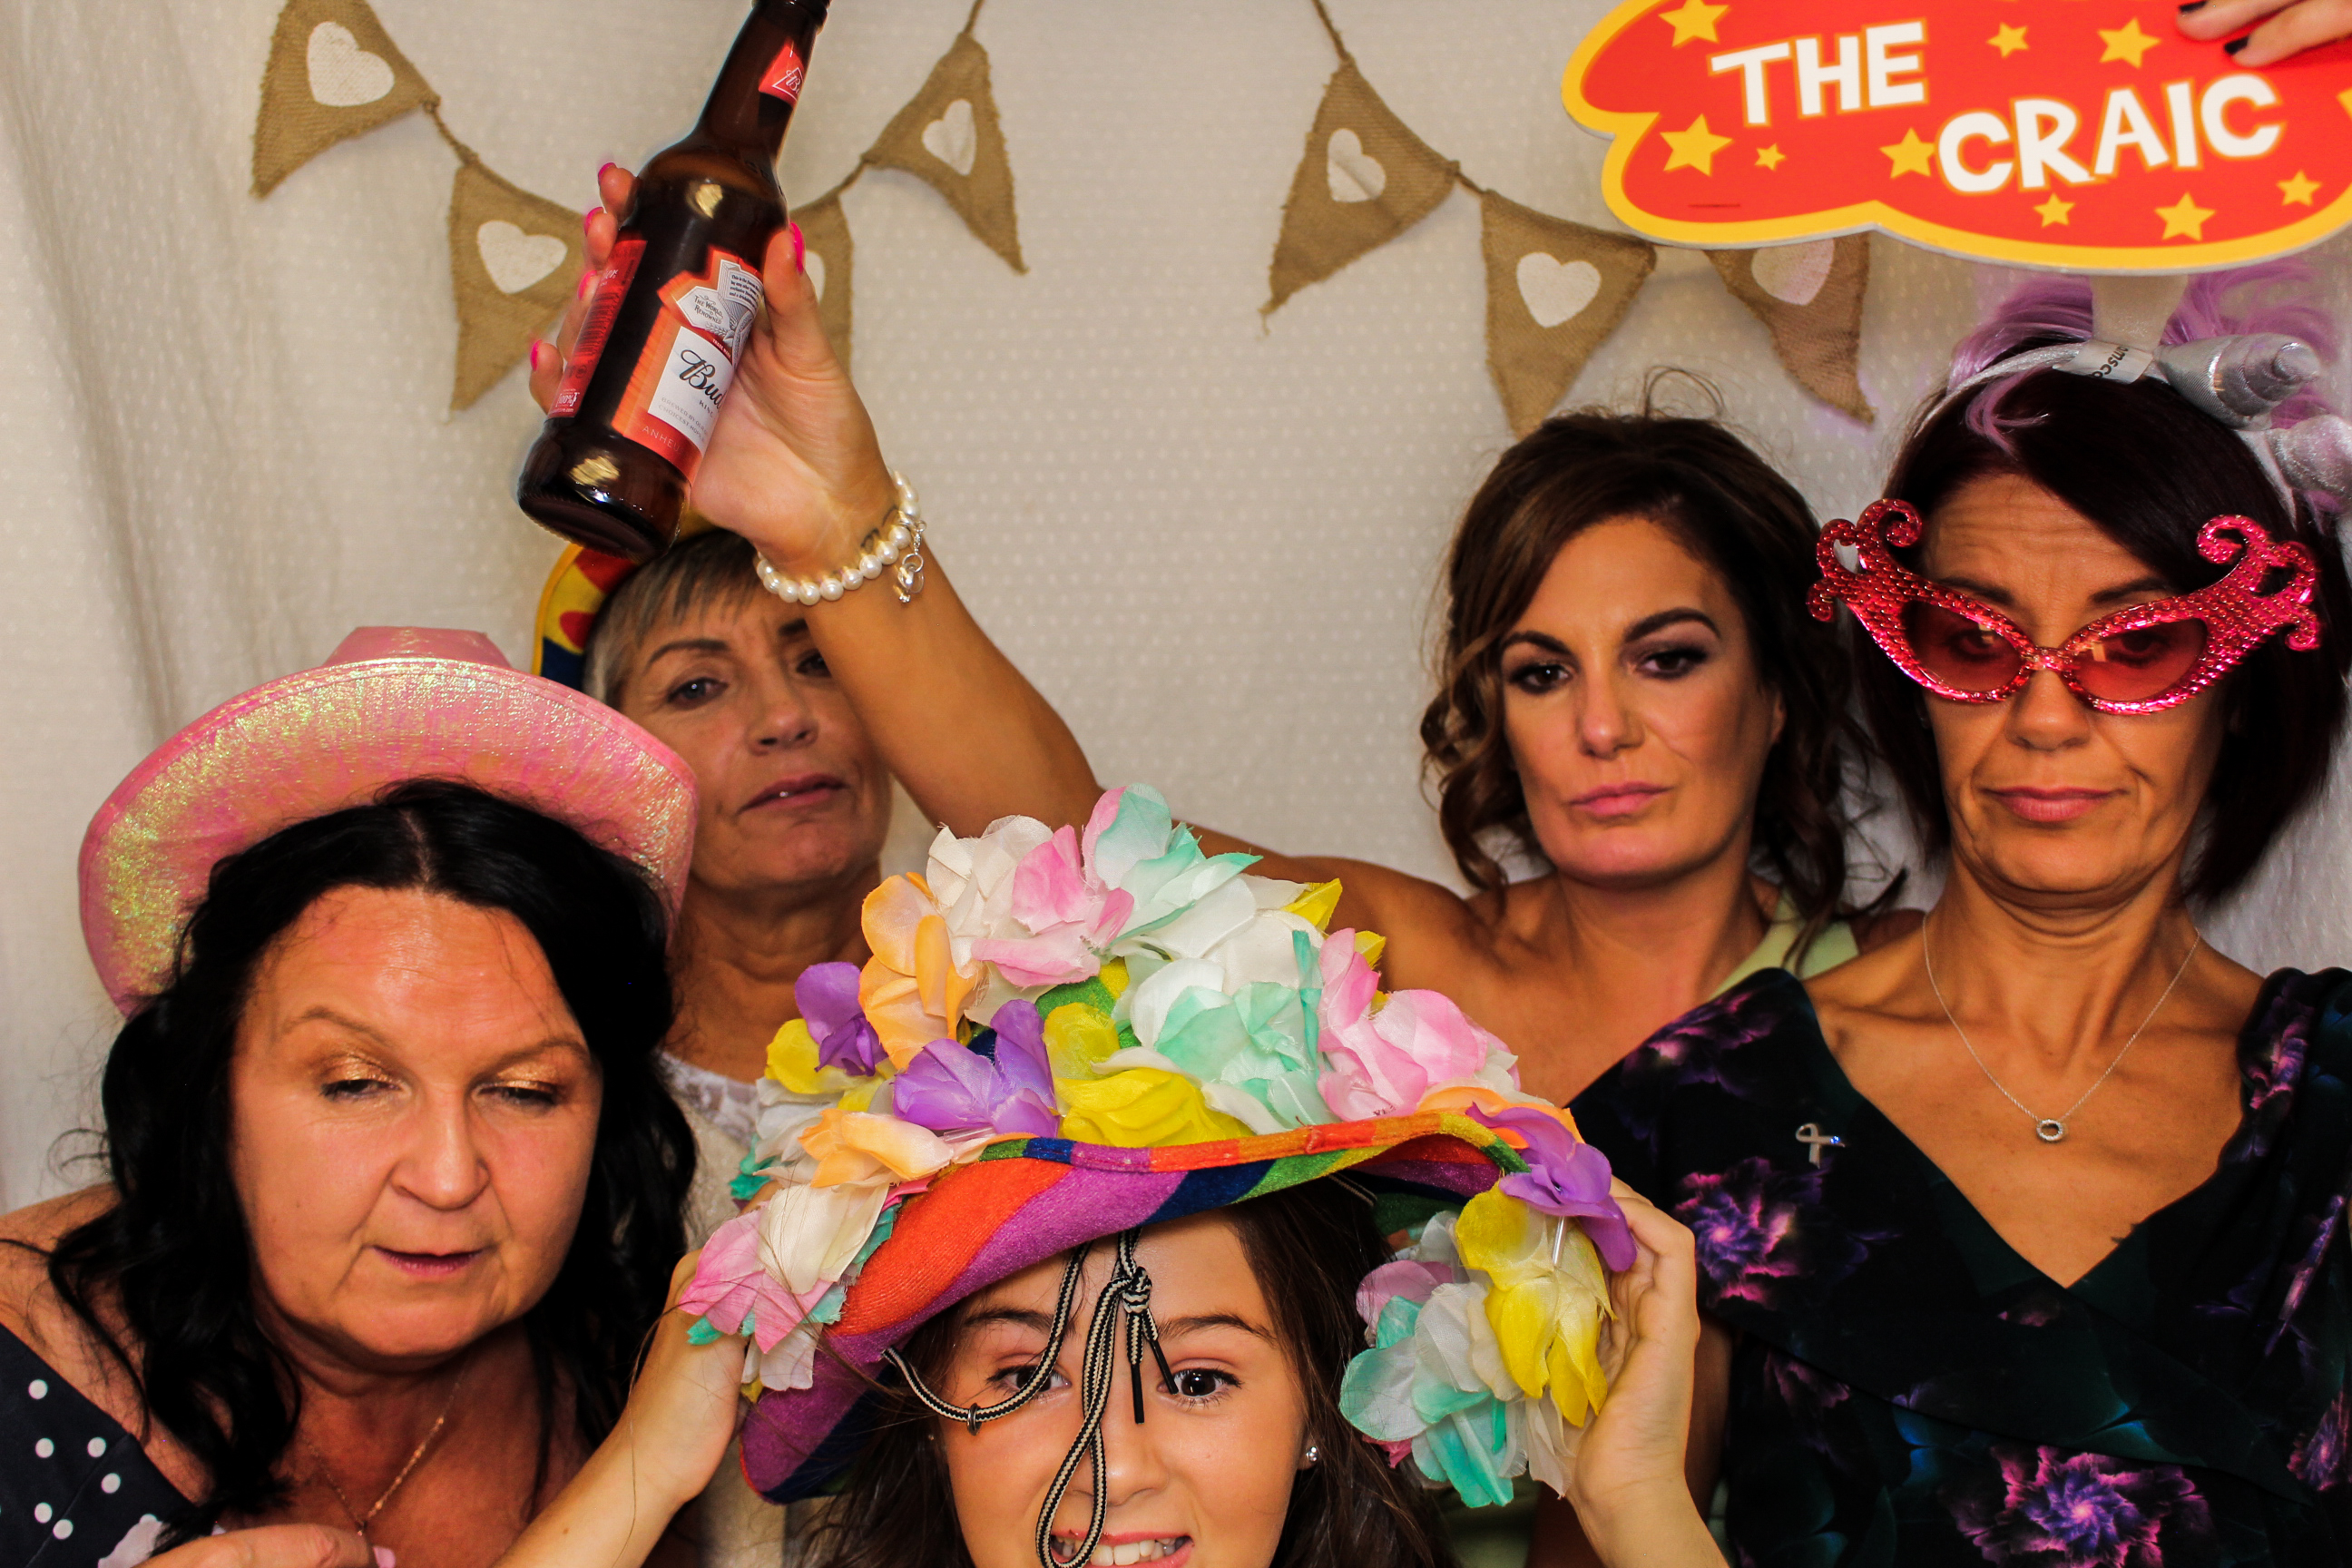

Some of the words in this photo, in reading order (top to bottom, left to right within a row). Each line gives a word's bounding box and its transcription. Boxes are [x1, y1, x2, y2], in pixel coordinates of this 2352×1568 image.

[1710, 20, 1926, 126] THE
[1937, 74, 2281, 194] CRAIC
[694, 304, 722, 325] RENOWNED
[642, 426, 682, 454] ANHEU
